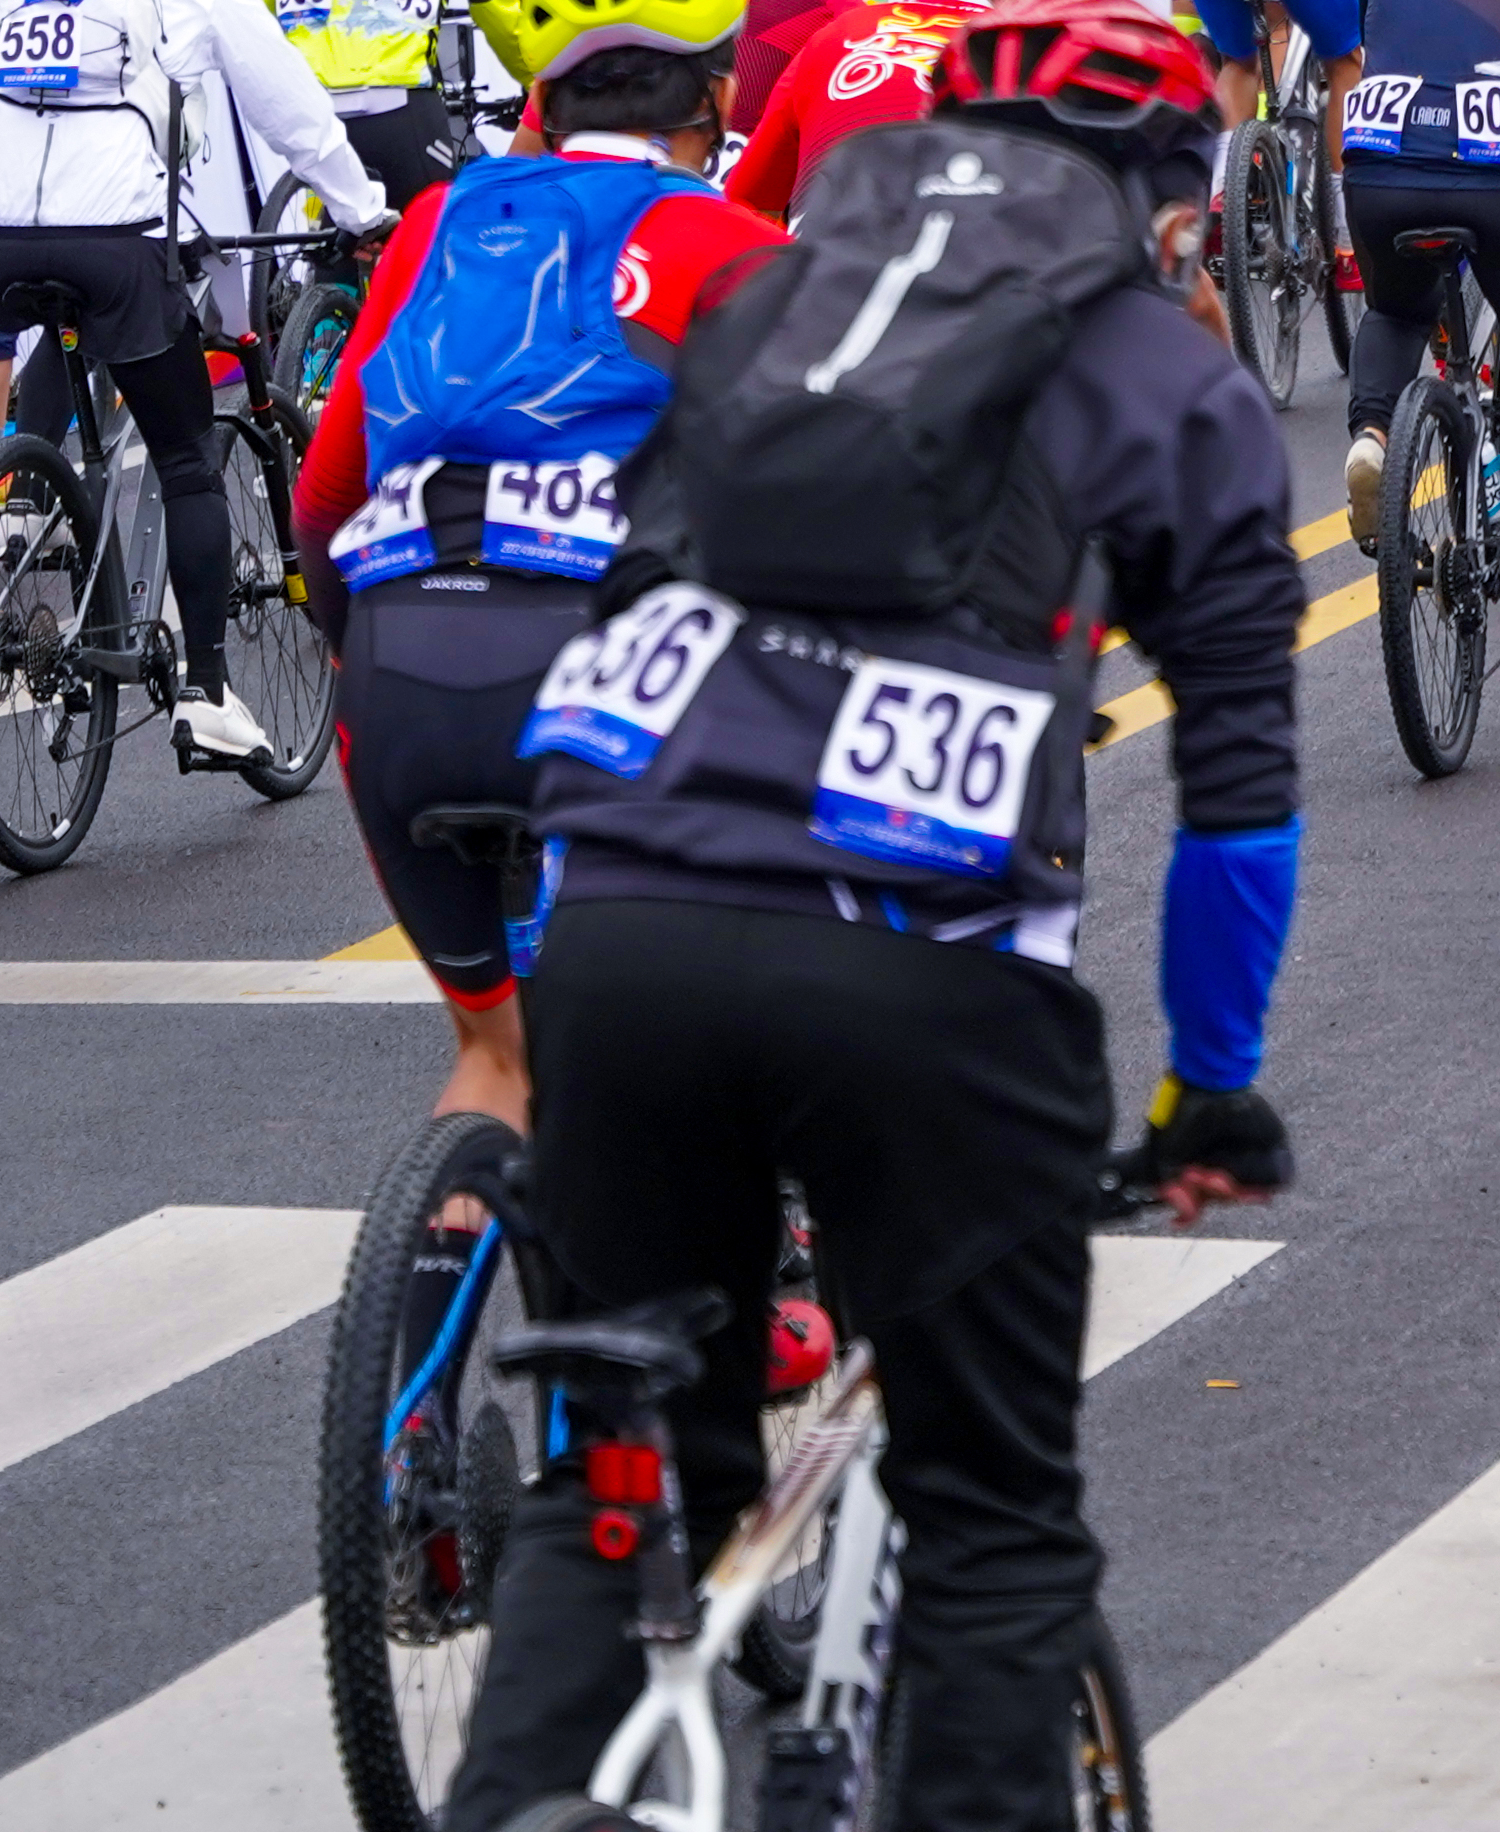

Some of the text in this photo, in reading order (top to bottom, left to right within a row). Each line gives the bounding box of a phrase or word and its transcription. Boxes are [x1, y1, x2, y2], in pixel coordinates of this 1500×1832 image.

[1, 13, 76, 63] 558
[1345, 79, 1412, 125] 602
[1410, 105, 1452, 128] LAMEDA
[848, 682, 1018, 810] 536
